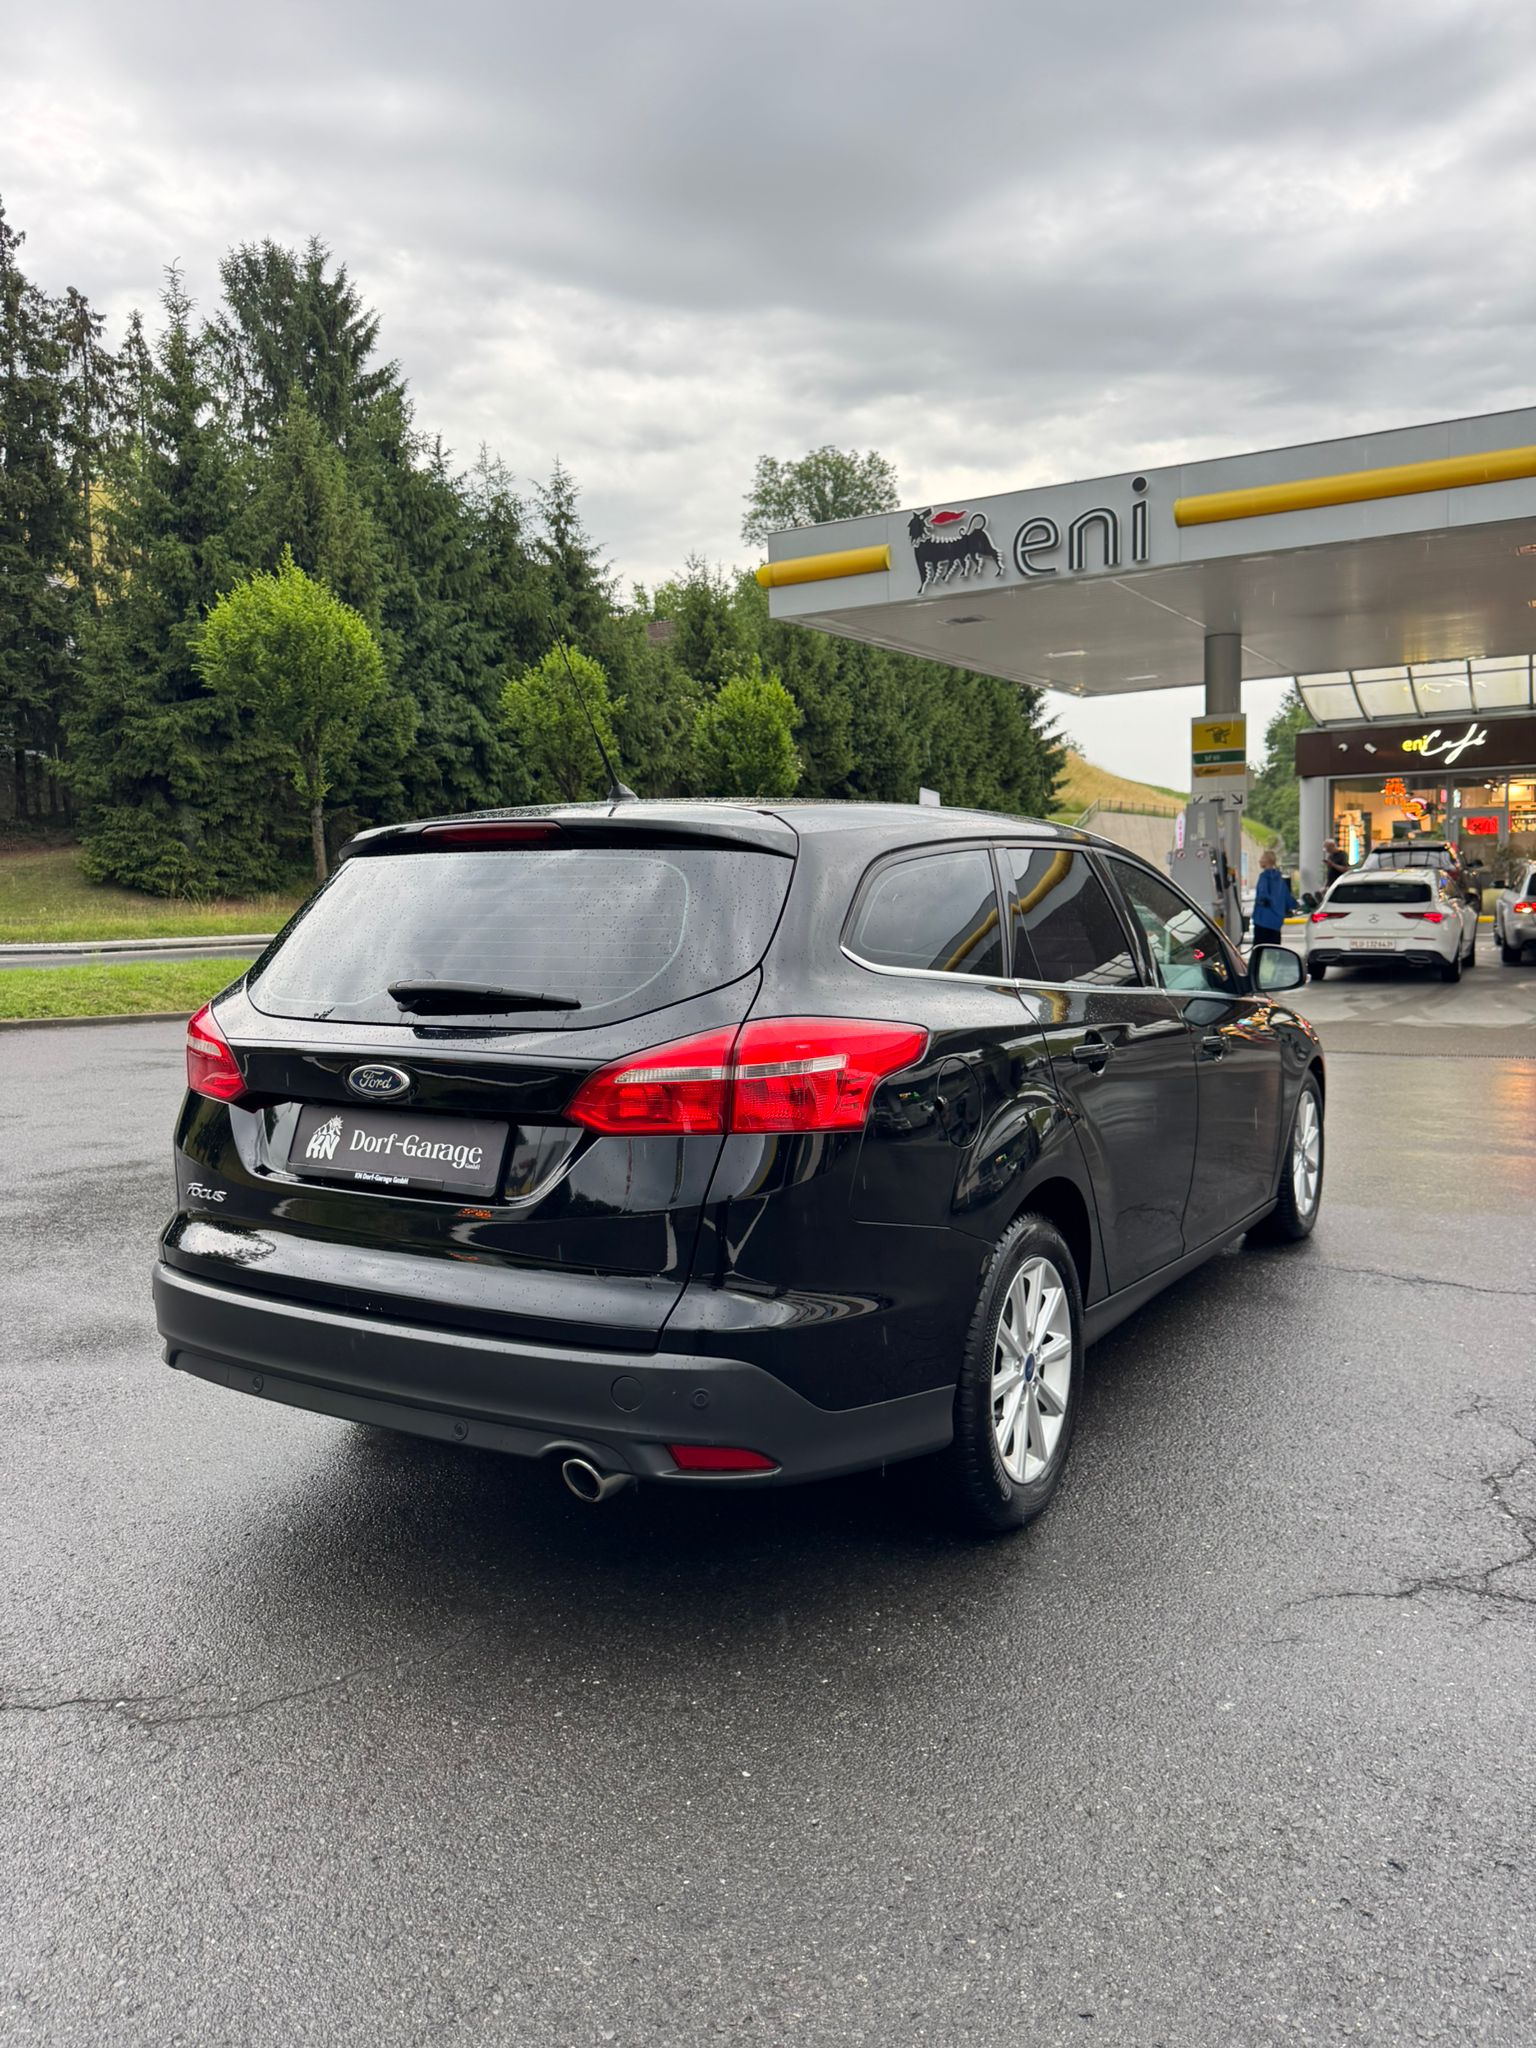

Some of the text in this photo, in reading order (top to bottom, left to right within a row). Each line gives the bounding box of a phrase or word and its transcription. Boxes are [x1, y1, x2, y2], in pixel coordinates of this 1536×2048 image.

[1012, 475, 1149, 578] eni
[1401, 734, 1429, 752] eni
[359, 1069, 393, 1090] Ford
[349, 1129, 483, 1169] Dorf-Garage
[354, 1172, 363, 1180] KN
[363, 1173, 393, 1184] Dorf-Garage
